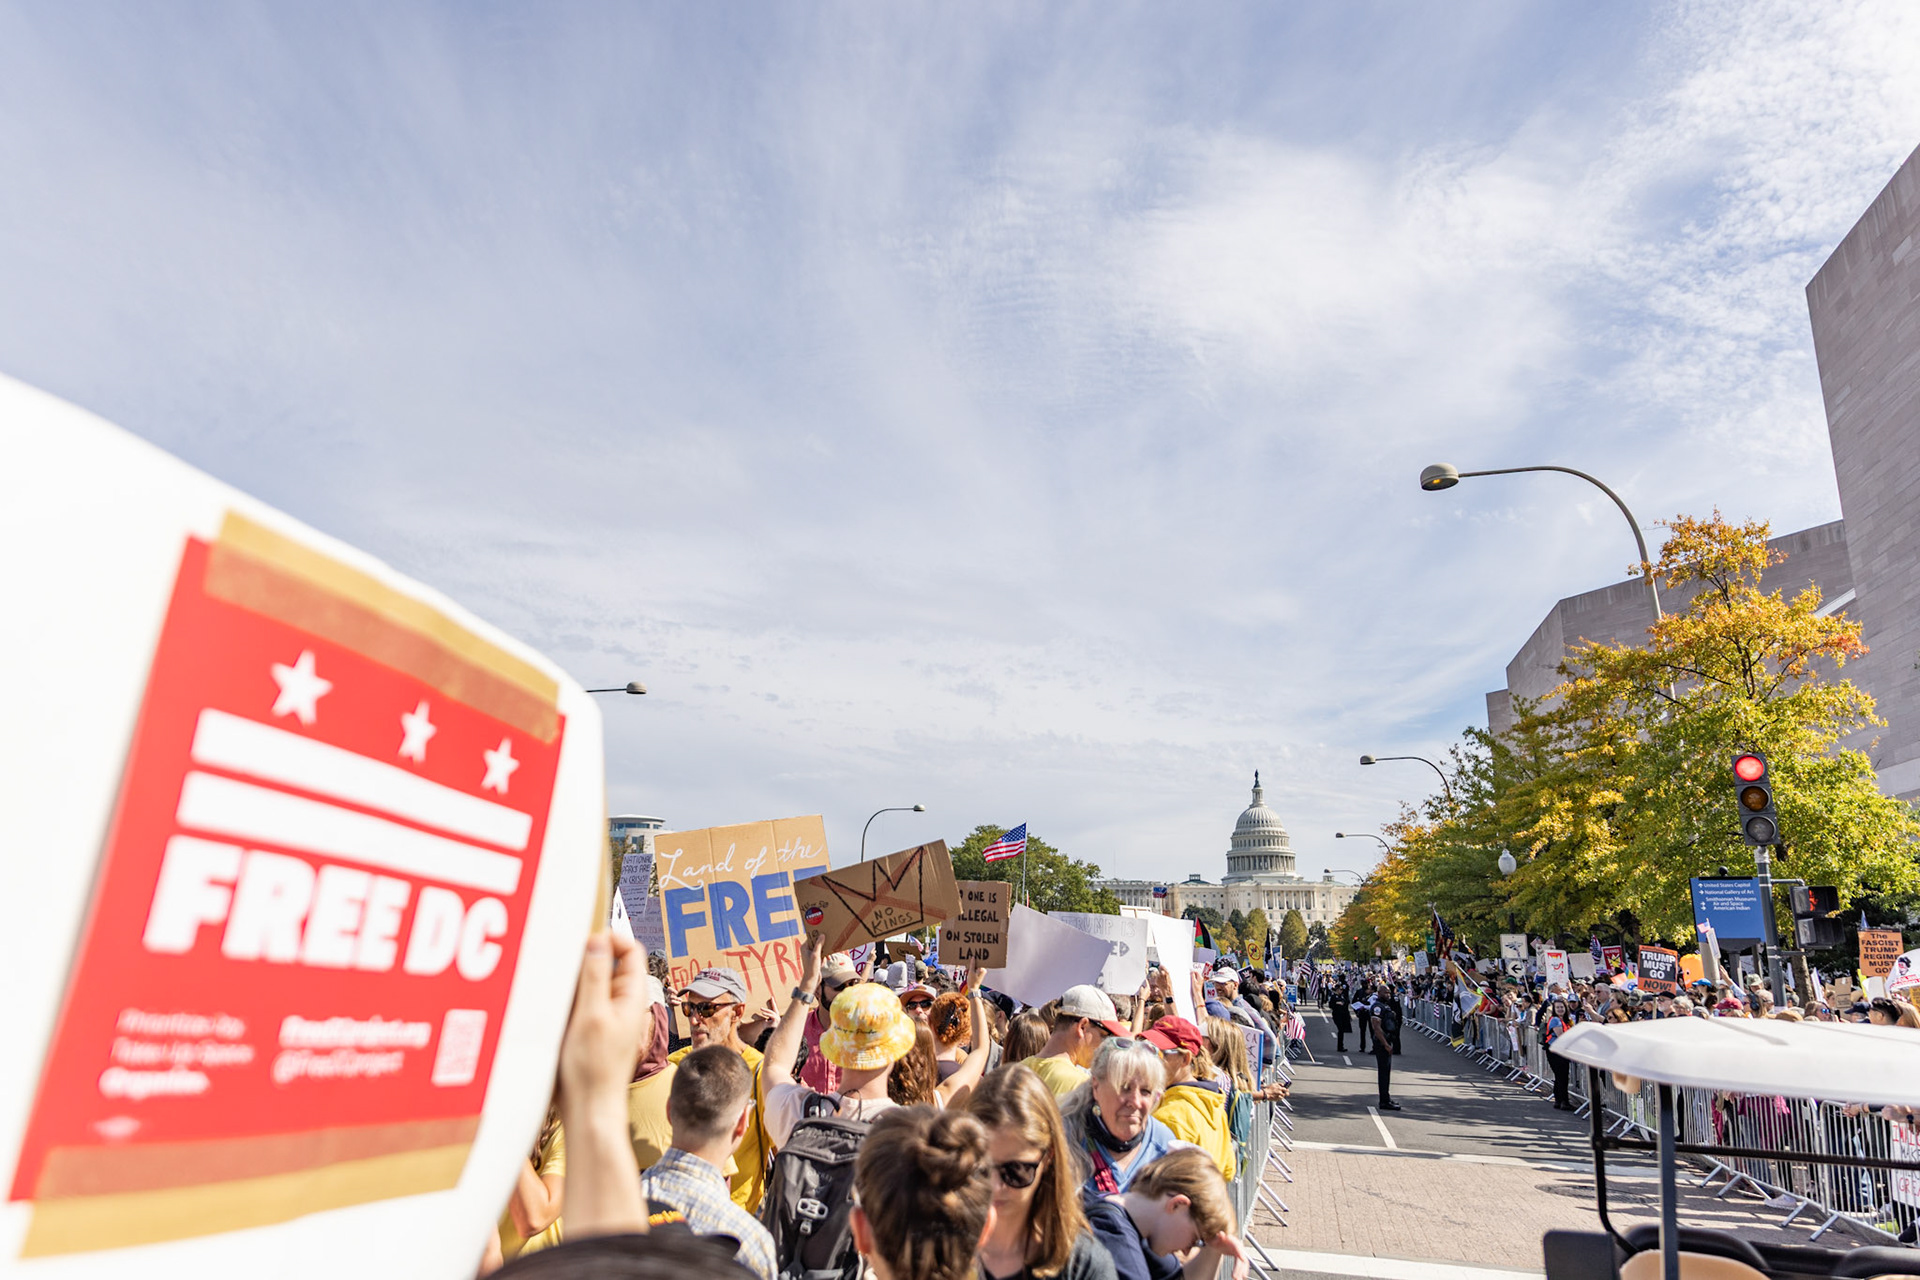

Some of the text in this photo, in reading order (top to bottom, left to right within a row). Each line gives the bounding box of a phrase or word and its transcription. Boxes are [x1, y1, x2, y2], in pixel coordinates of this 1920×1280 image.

[624, 855, 652, 864] NATIONAL
[659, 837, 824, 890] Land of the
[968, 891, 985, 902] ONE
[989, 892, 997, 904] IS
[141, 833, 509, 982] FREE DC
[874, 907, 894, 919] NO
[871, 912, 913, 933] KINGS
[1061, 916, 1135, 938] TRUMP IS
[946, 931, 999, 944] ON STOLEN
[959, 947, 990, 960] LAND
[1641, 951, 1676, 963] TRUMP
[1643, 960, 1672, 971] MUST
[1649, 970, 1665, 979] GO
[1643, 980, 1672, 991] NOW!
